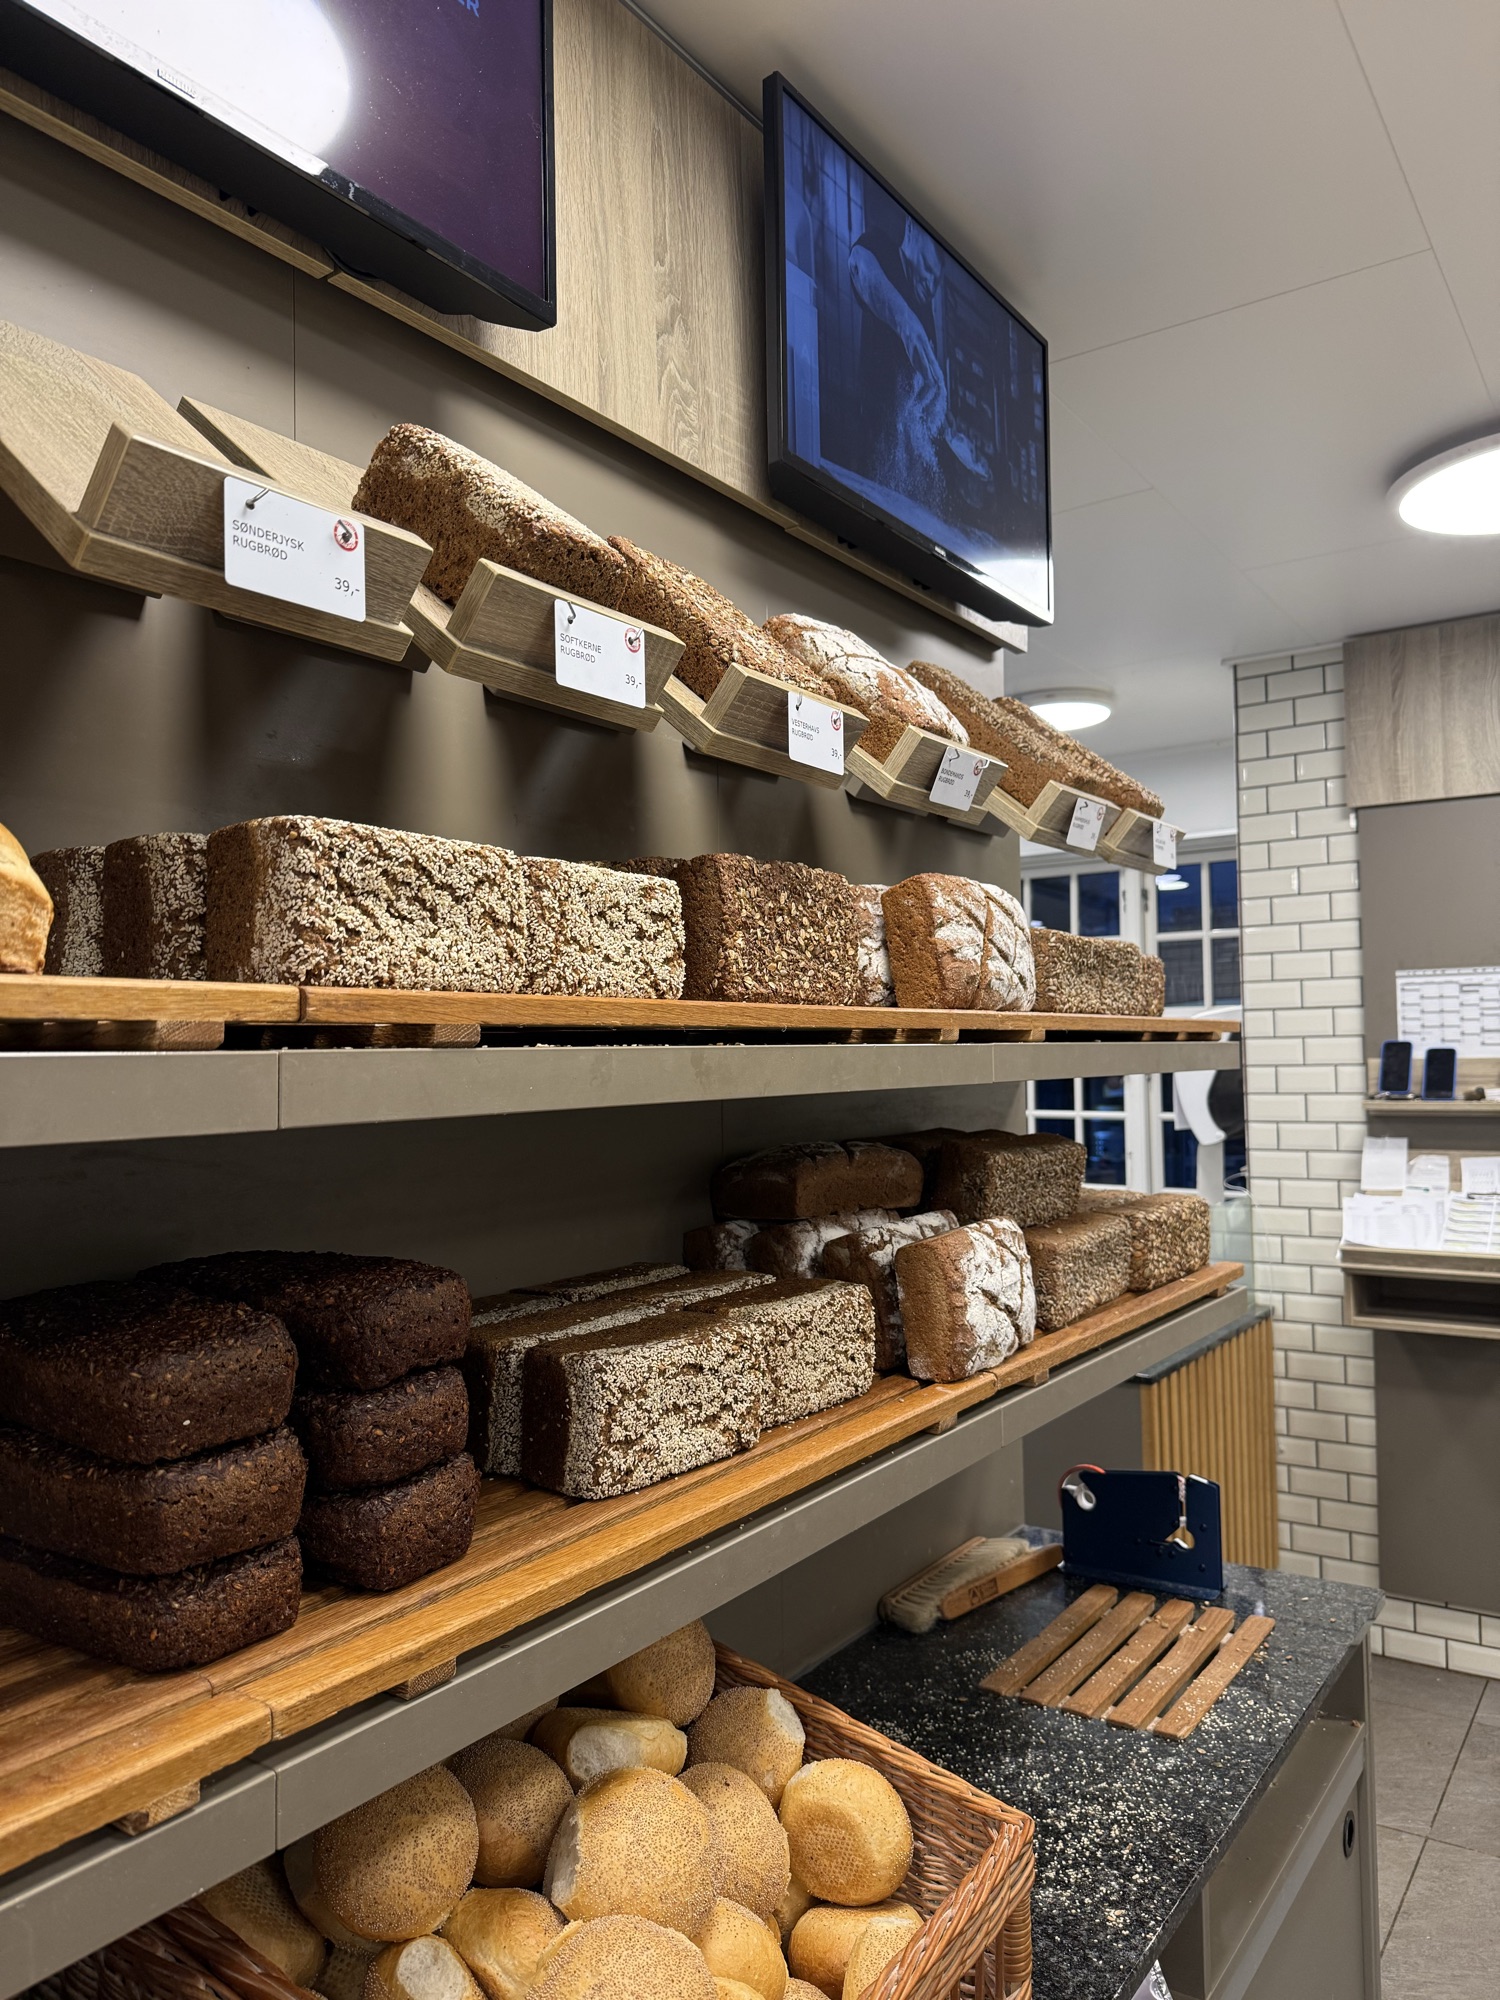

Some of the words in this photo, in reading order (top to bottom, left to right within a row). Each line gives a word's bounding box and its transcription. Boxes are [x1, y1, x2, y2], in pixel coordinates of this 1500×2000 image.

[232, 519, 305, 552] SØNDERJYSK
[232, 535, 288, 561] RUGBRØD
[334, 577, 360, 597] 39,-
[560, 633, 602, 654] SOFTKERNE
[560, 645, 596, 664] RUGBRØD
[625, 674, 642, 689] 39,-
